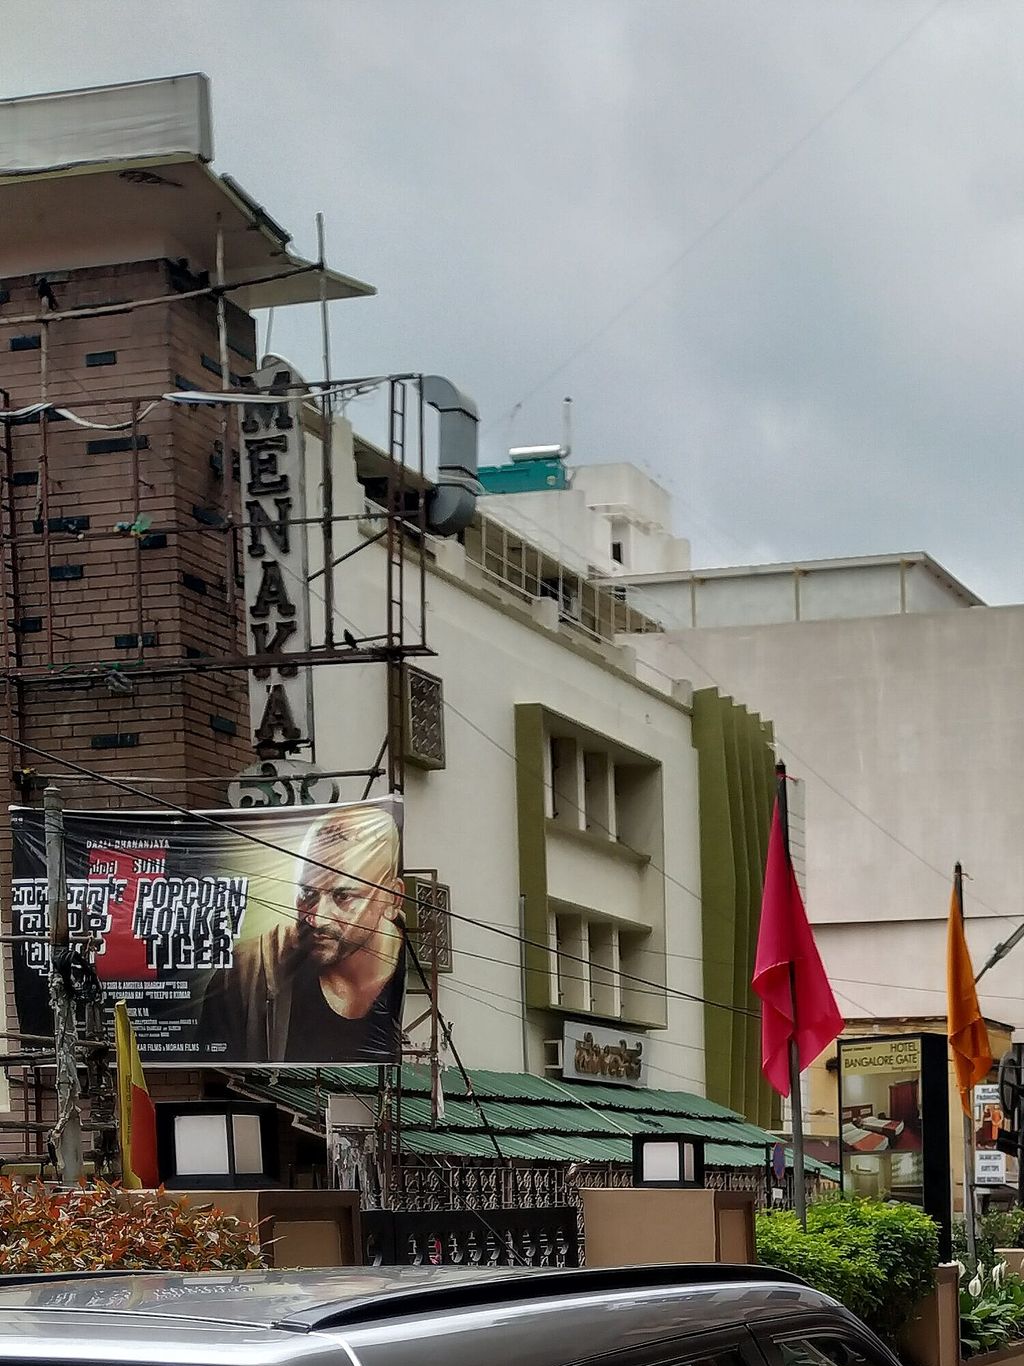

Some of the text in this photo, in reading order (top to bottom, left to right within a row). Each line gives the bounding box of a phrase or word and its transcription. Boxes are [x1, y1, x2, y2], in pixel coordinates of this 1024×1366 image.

[135, 875, 248, 909] POPCORN
[132, 905, 244, 939] MONKEY
[143, 934, 234, 969] TIGER
[844, 1052, 918, 1069] BANGALORE GATE
[890, 1042, 918, 1053] HOTEL
